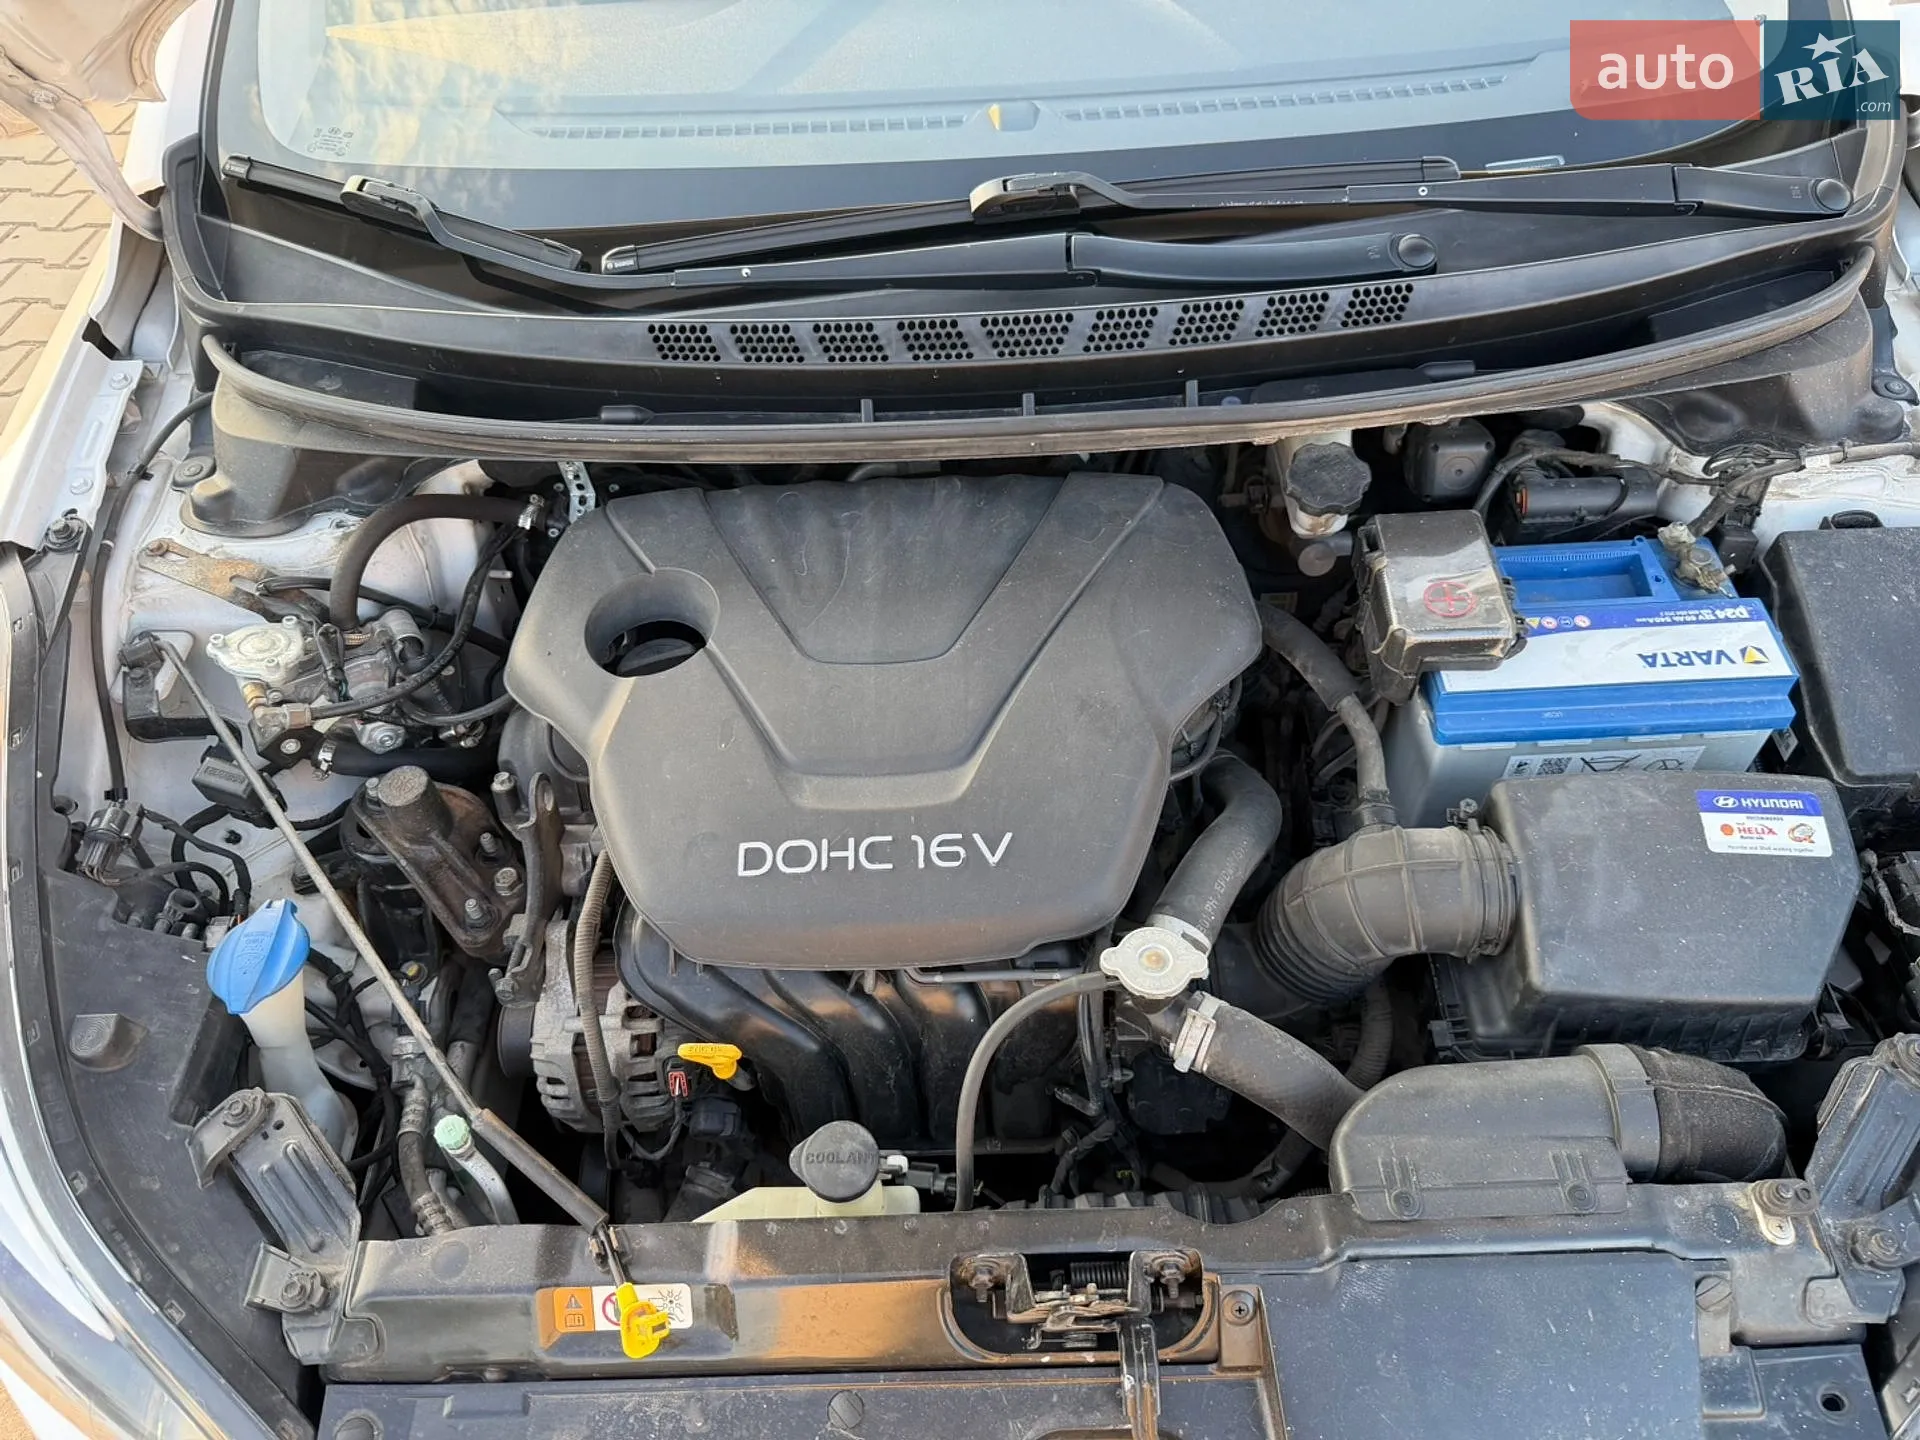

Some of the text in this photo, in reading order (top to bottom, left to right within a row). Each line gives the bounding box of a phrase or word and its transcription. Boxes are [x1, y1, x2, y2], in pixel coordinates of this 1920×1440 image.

[1636, 649, 1737, 668] VARTA
[1740, 798, 1805, 810] HYUNDAI
[1737, 824, 1778, 836] HELIX
[738, 835, 893, 877] DOHC
[805, 1151, 878, 1165] COOLANT
